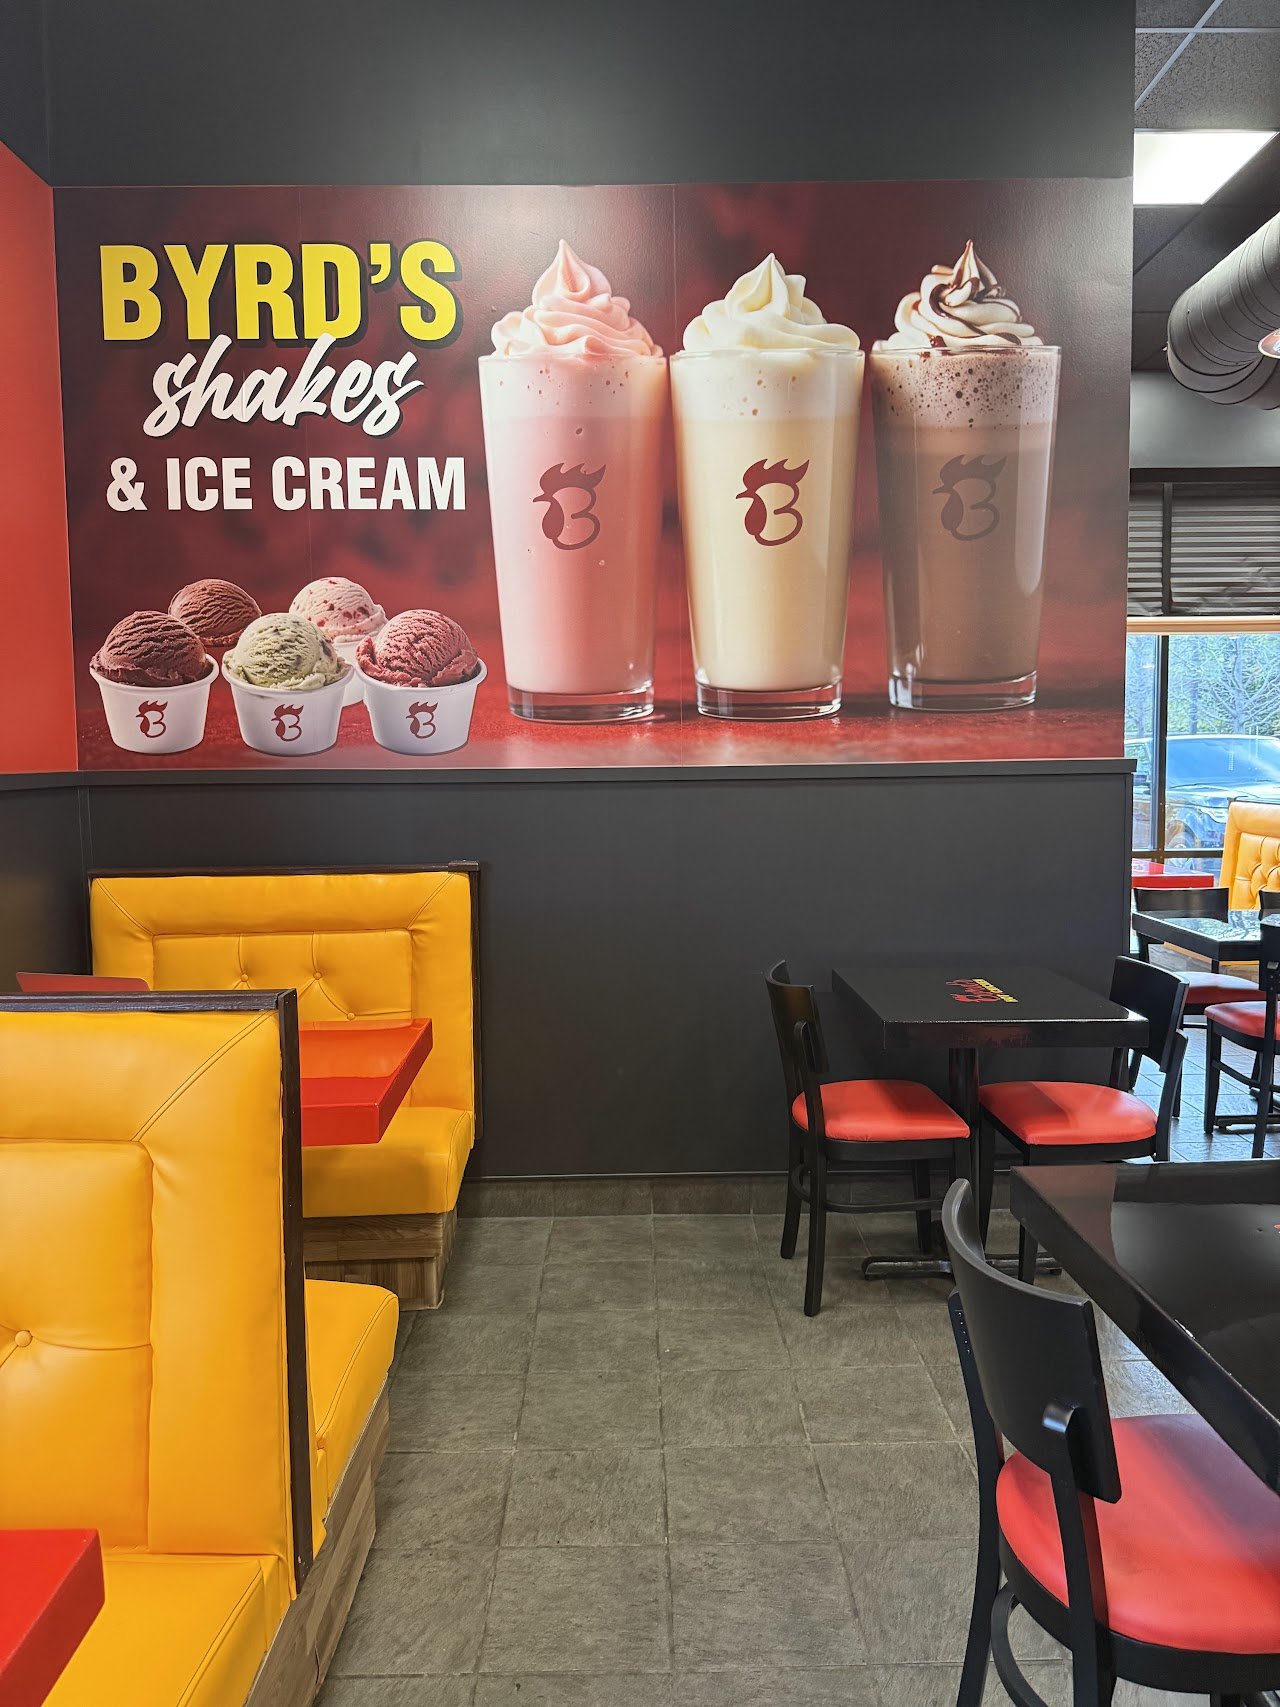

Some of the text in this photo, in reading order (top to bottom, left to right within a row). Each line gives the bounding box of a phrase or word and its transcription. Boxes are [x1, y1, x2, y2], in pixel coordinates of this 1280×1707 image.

[100, 240, 458, 342] BYRD'S
[143, 333, 425, 437] shakes
[106, 456, 466, 512] & ICE CREAM
